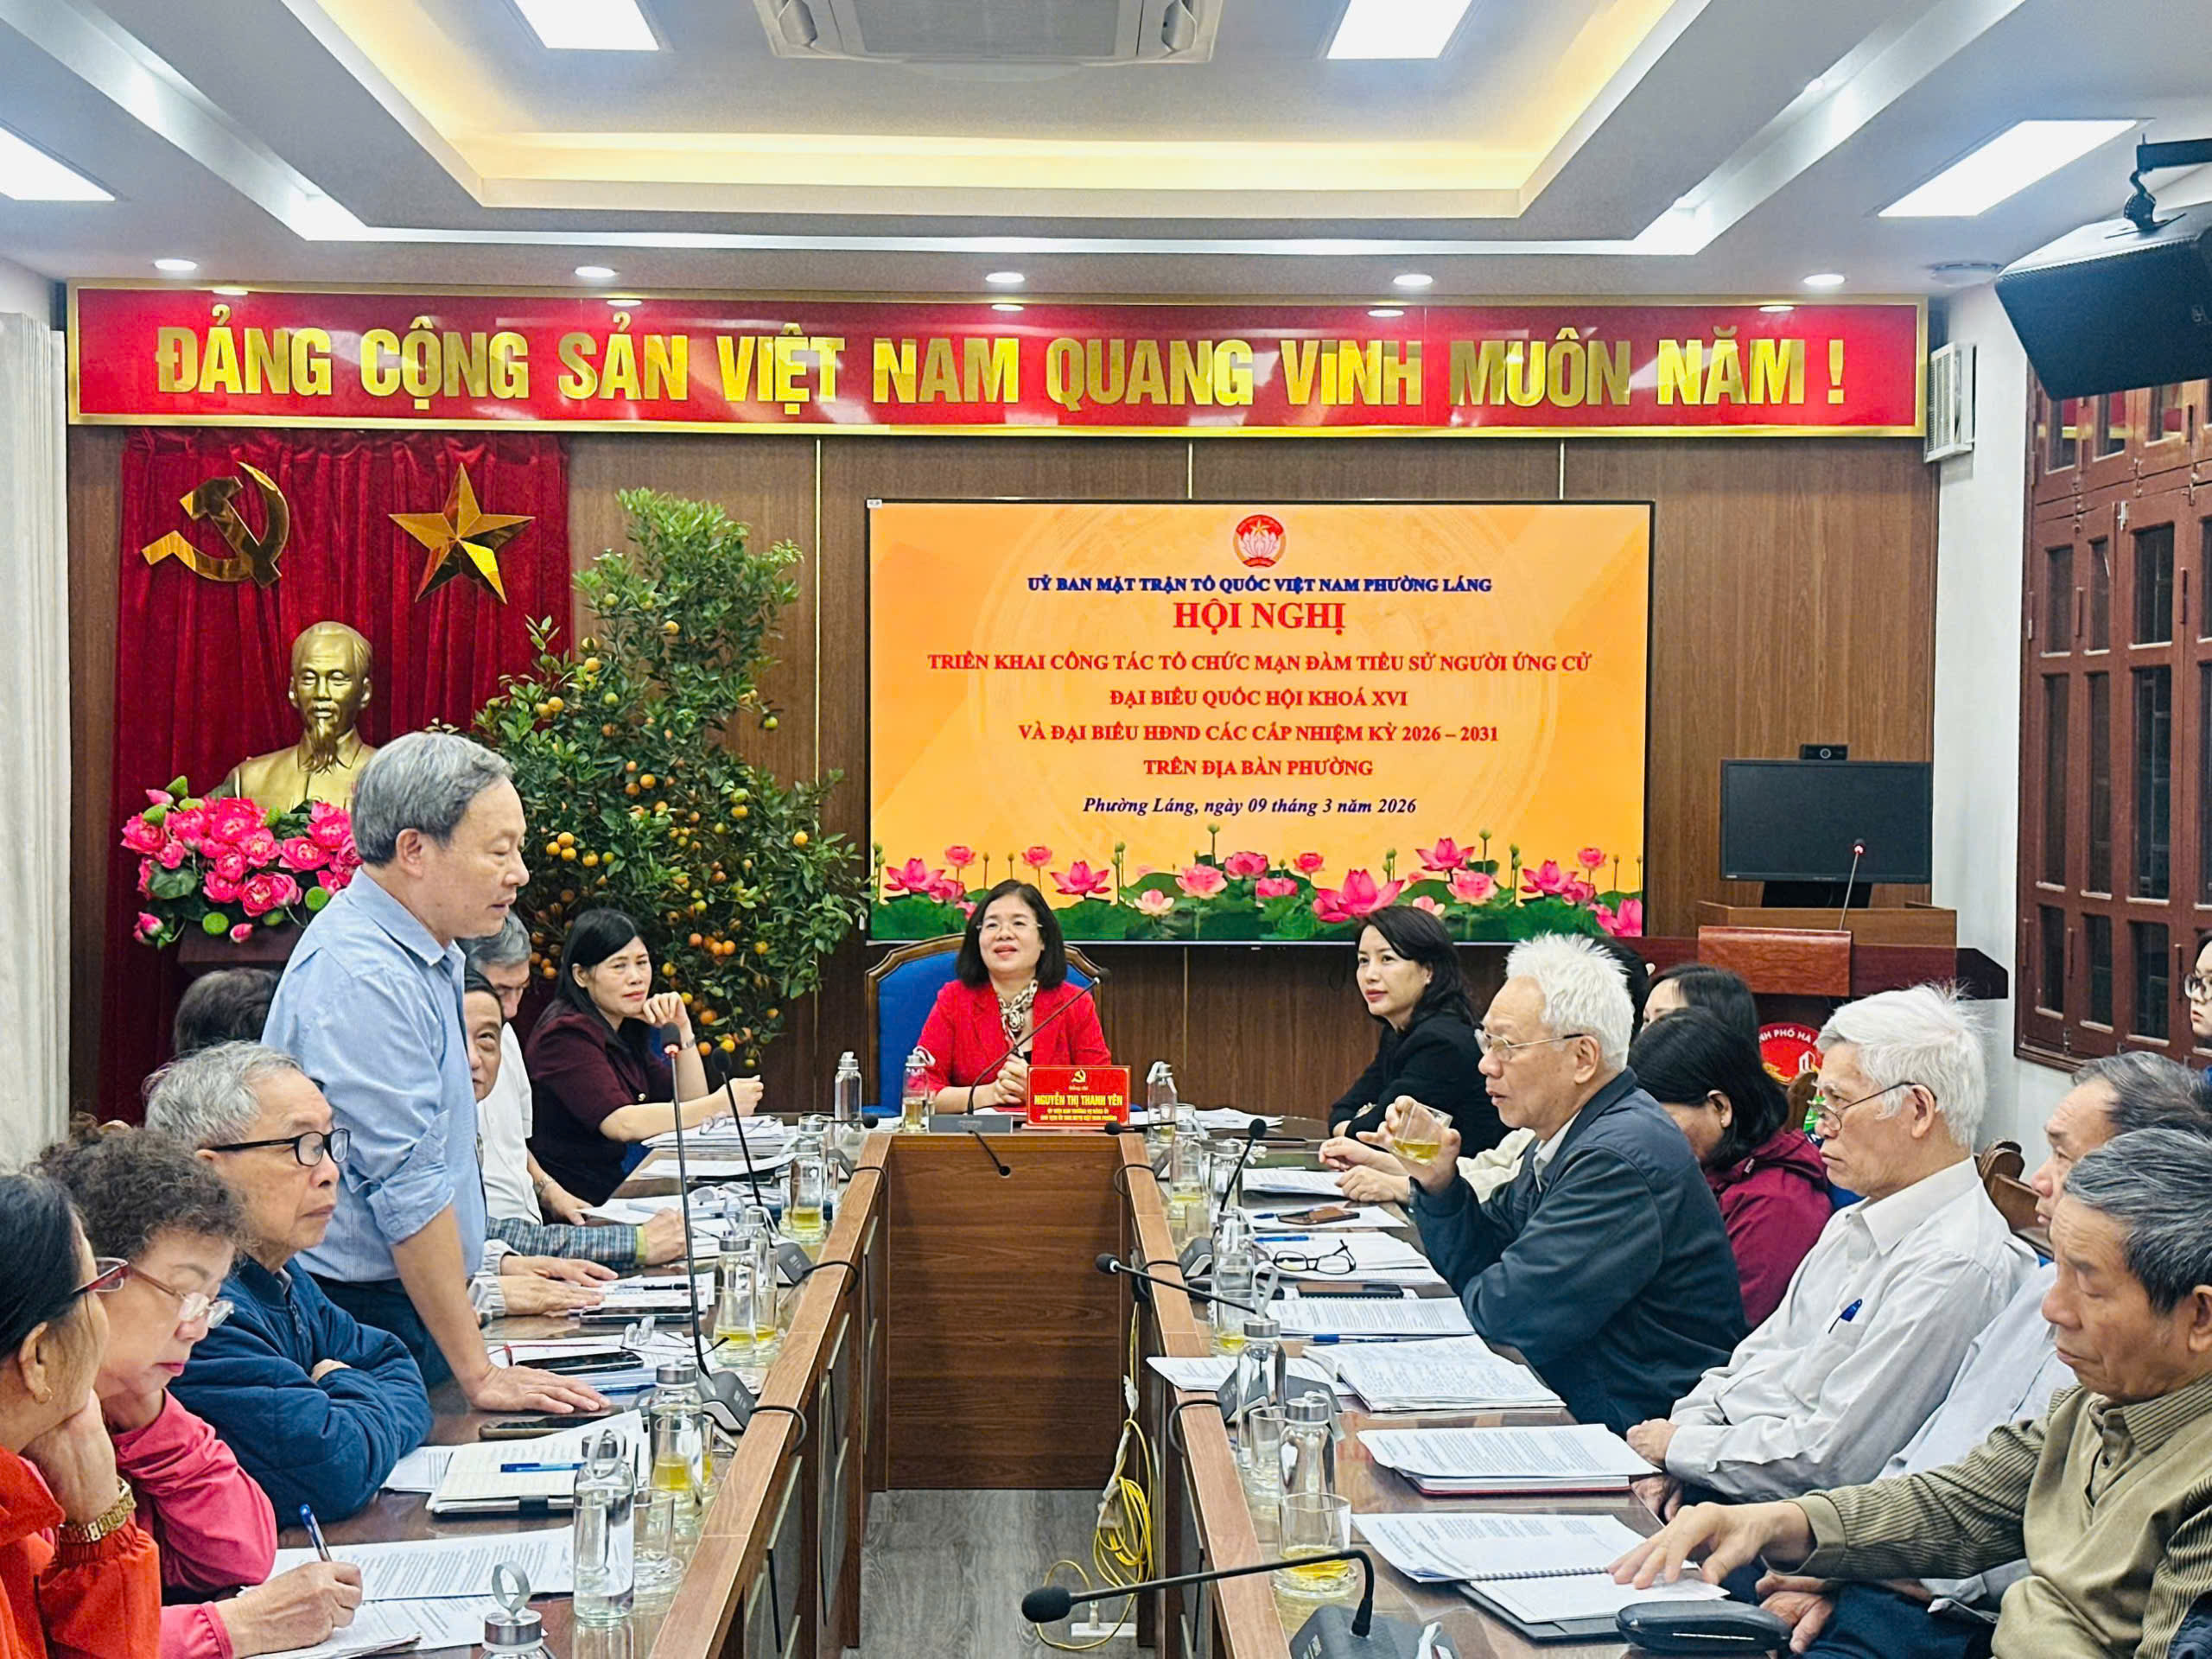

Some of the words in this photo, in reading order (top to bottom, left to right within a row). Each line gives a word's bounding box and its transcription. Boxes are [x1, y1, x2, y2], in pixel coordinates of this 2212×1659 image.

[157, 304, 333, 397] ĐẢNG
[359, 316, 529, 410] CỘNG
[558, 312, 688, 400] SẢN
[715, 322, 847, 415] VIỆT
[872, 337, 1020, 404] NAM
[1046, 337, 1255, 412] QUANG
[1280, 340, 1423, 405] VINH
[1448, 327, 1632, 406] MUÔN
[1656, 326, 1806, 405] NĂM
[1827, 340, 1846, 404] !
[1056, 577, 1092, 591] BAN
[1138, 575, 1187, 594] TRẬN
[1274, 576, 1316, 595] VIỆT
[1319, 578, 1360, 592] NAM
[1363, 575, 1439, 592] PHƯỜNG
[1442, 575, 1492, 593] LÁNG
[1173, 597, 1243, 636] HỘI
[1250, 601, 1346, 636] NGHỊ
[994, 654, 1046, 671] KHAI
[1050, 650, 1109, 671] CÔNG
[1112, 650, 1154, 671] TÁC
[1191, 651, 1250, 671] CHỨC
[1254, 655, 1300, 675] MẠN
[1306, 651, 1352, 671] ĐÀM
[1408, 651, 1437, 671] SỬ
[1440, 651, 1508, 671] NGƯỜI
[1512, 651, 1557, 671] ỨNG
[1561, 651, 1592, 671] CỬ
[1109, 690, 1146, 709] ĐẠI
[1265, 688, 1303, 710] HỘI
[1307, 686, 1368, 706] KHOÁ
[1371, 690, 1408, 707] XVI
[1018, 721, 1046, 741] VÀ
[1051, 725, 1087, 744] ĐẠI
[1143, 725, 1201, 741] HĐND
[1205, 721, 1248, 741] CÁC
[1295, 723, 1363, 745] NHIỆM
[1368, 721, 1397, 741] KỲ
[1402, 725, 1441, 742] 2026
[1460, 725, 1497, 742] 2031
[1143, 755, 1197, 775] TRÊN
[1202, 760, 1238, 779] ĐỊA
[1241, 756, 1282, 776] BÀN
[1287, 756, 1374, 776] PHƯỜNG
[1083, 798, 1148, 817] Phường
[1152, 798, 1198, 817] Láng,
[1204, 798, 1243, 817] ngày
[1248, 798, 1268, 813] 09
[1271, 798, 1319, 817] tháng
[1322, 798, 1332, 813] 3
[1337, 799, 1372, 813] năm
[1377, 798, 1416, 813] 2026
